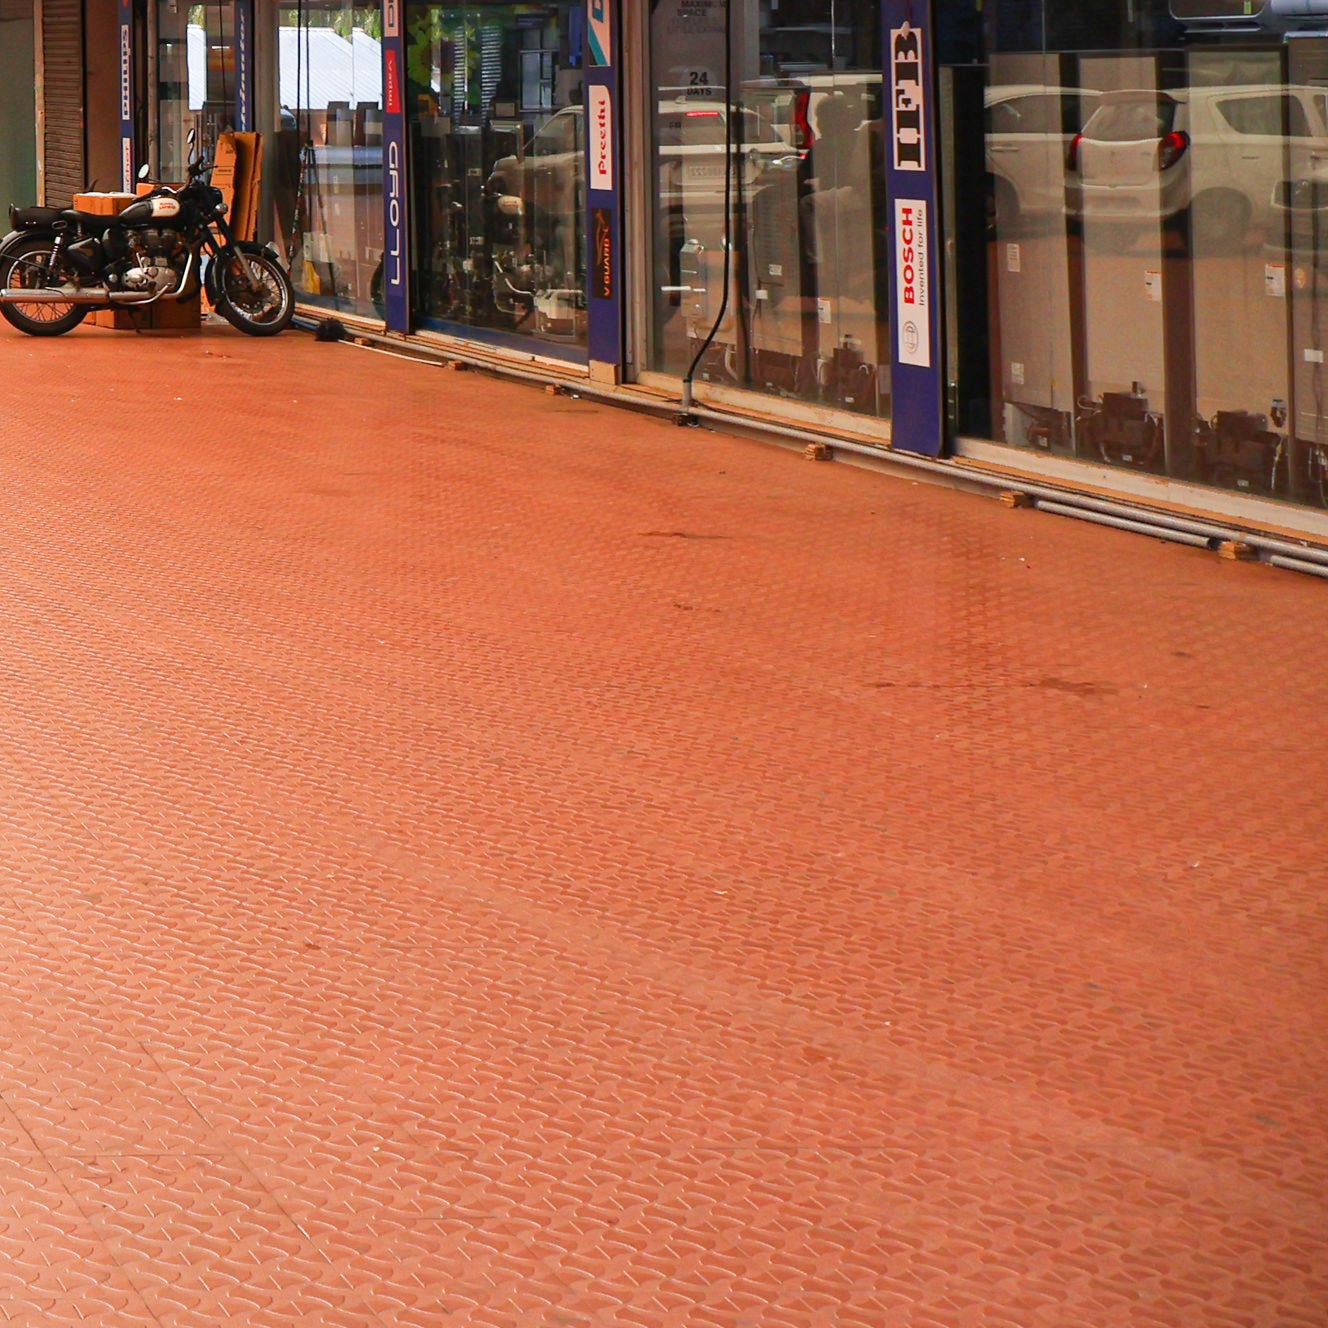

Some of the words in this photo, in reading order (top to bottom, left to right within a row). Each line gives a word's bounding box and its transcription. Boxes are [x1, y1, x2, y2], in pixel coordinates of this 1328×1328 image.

[690, 72, 709, 85] 24
[897, 28, 922, 170] IFB
[597, 100, 607, 175] Preethi
[388, 140, 401, 285] LLOYD
[916, 231, 924, 248] for
[901, 208, 915, 305] BOSCH
[917, 252, 925, 306] Invented
